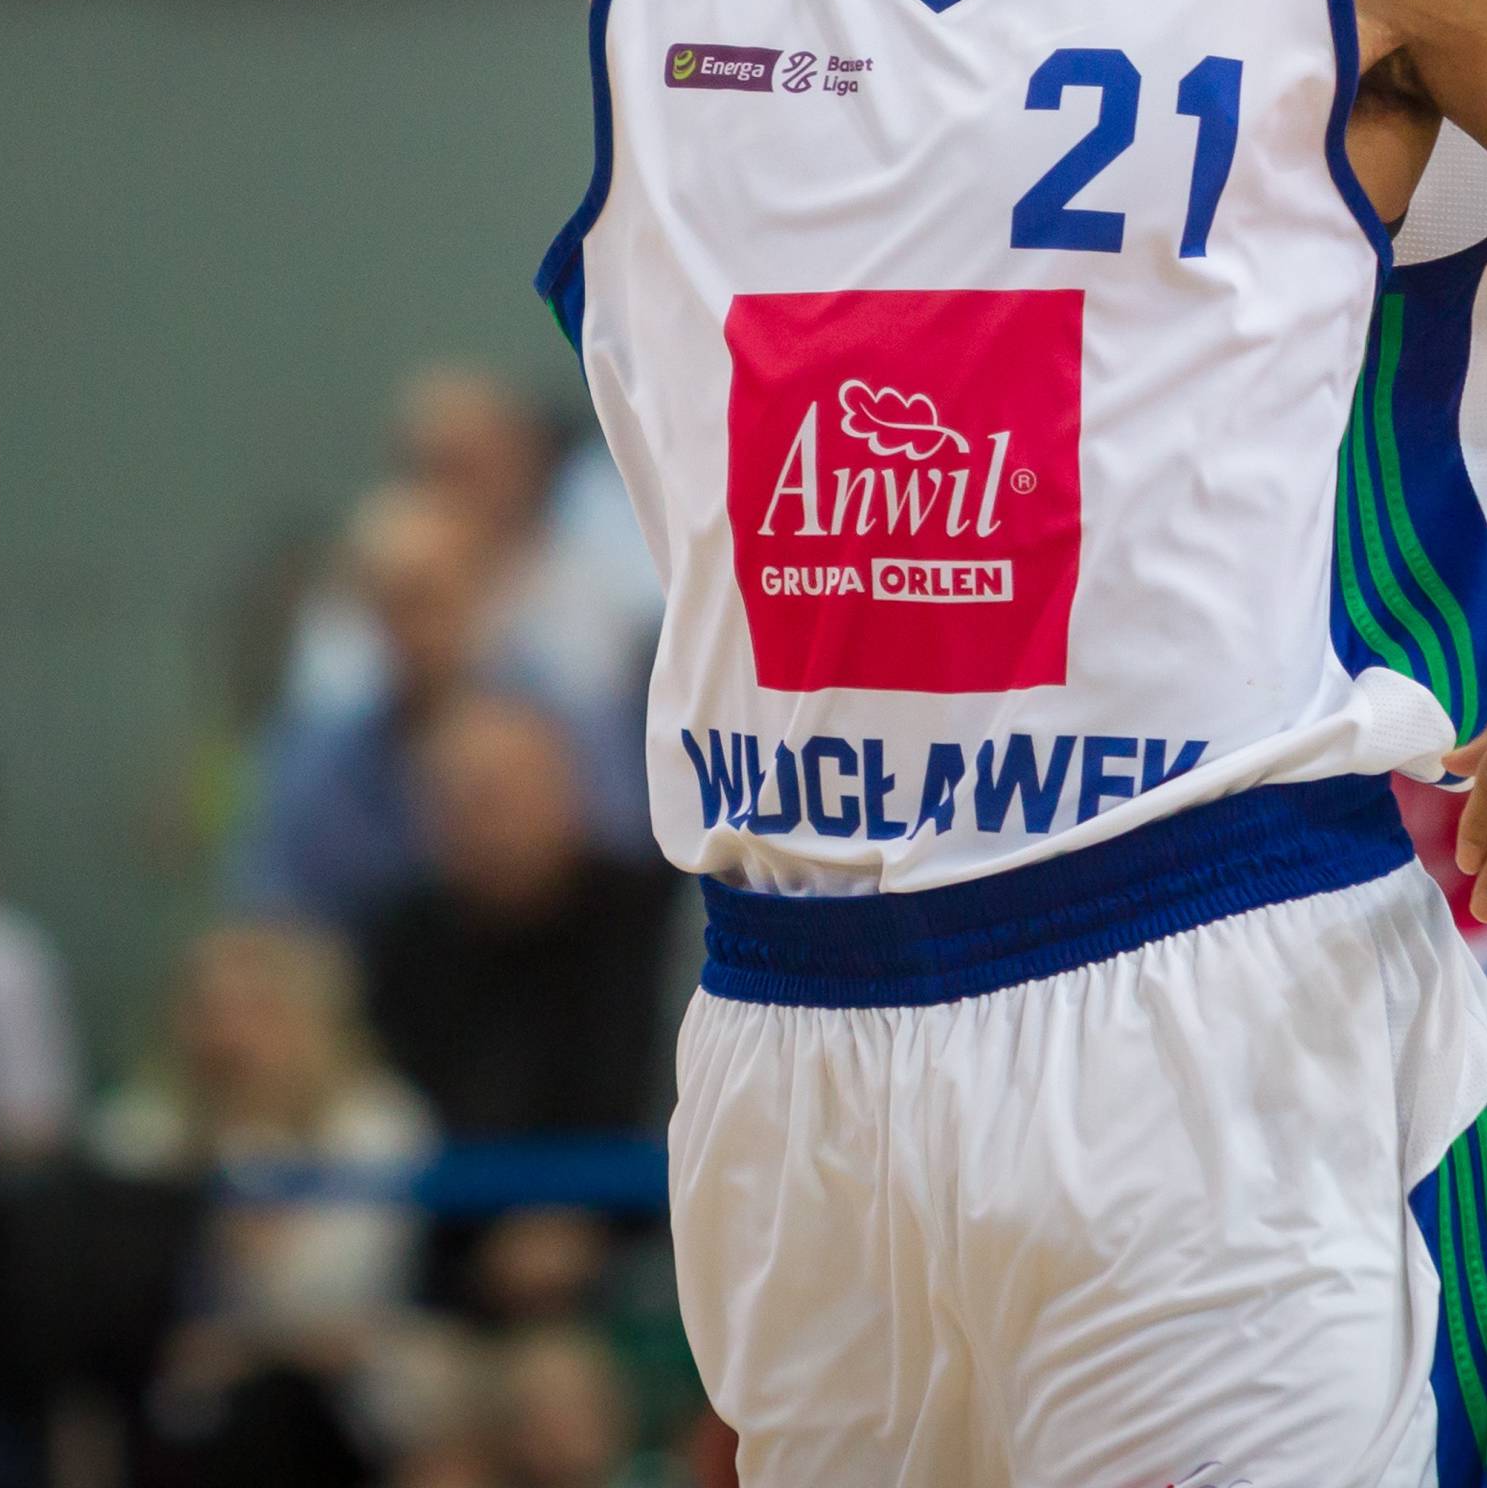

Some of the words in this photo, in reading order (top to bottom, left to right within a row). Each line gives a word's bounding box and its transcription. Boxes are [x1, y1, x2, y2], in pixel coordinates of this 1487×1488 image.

[700, 57, 765, 81] Energa
[827, 55, 874, 73] Baset
[823, 75, 859, 96] Liga
[1010, 48, 1244, 259] 21
[761, 565, 865, 597] GRUPA
[879, 564, 1003, 597] ORLEN
